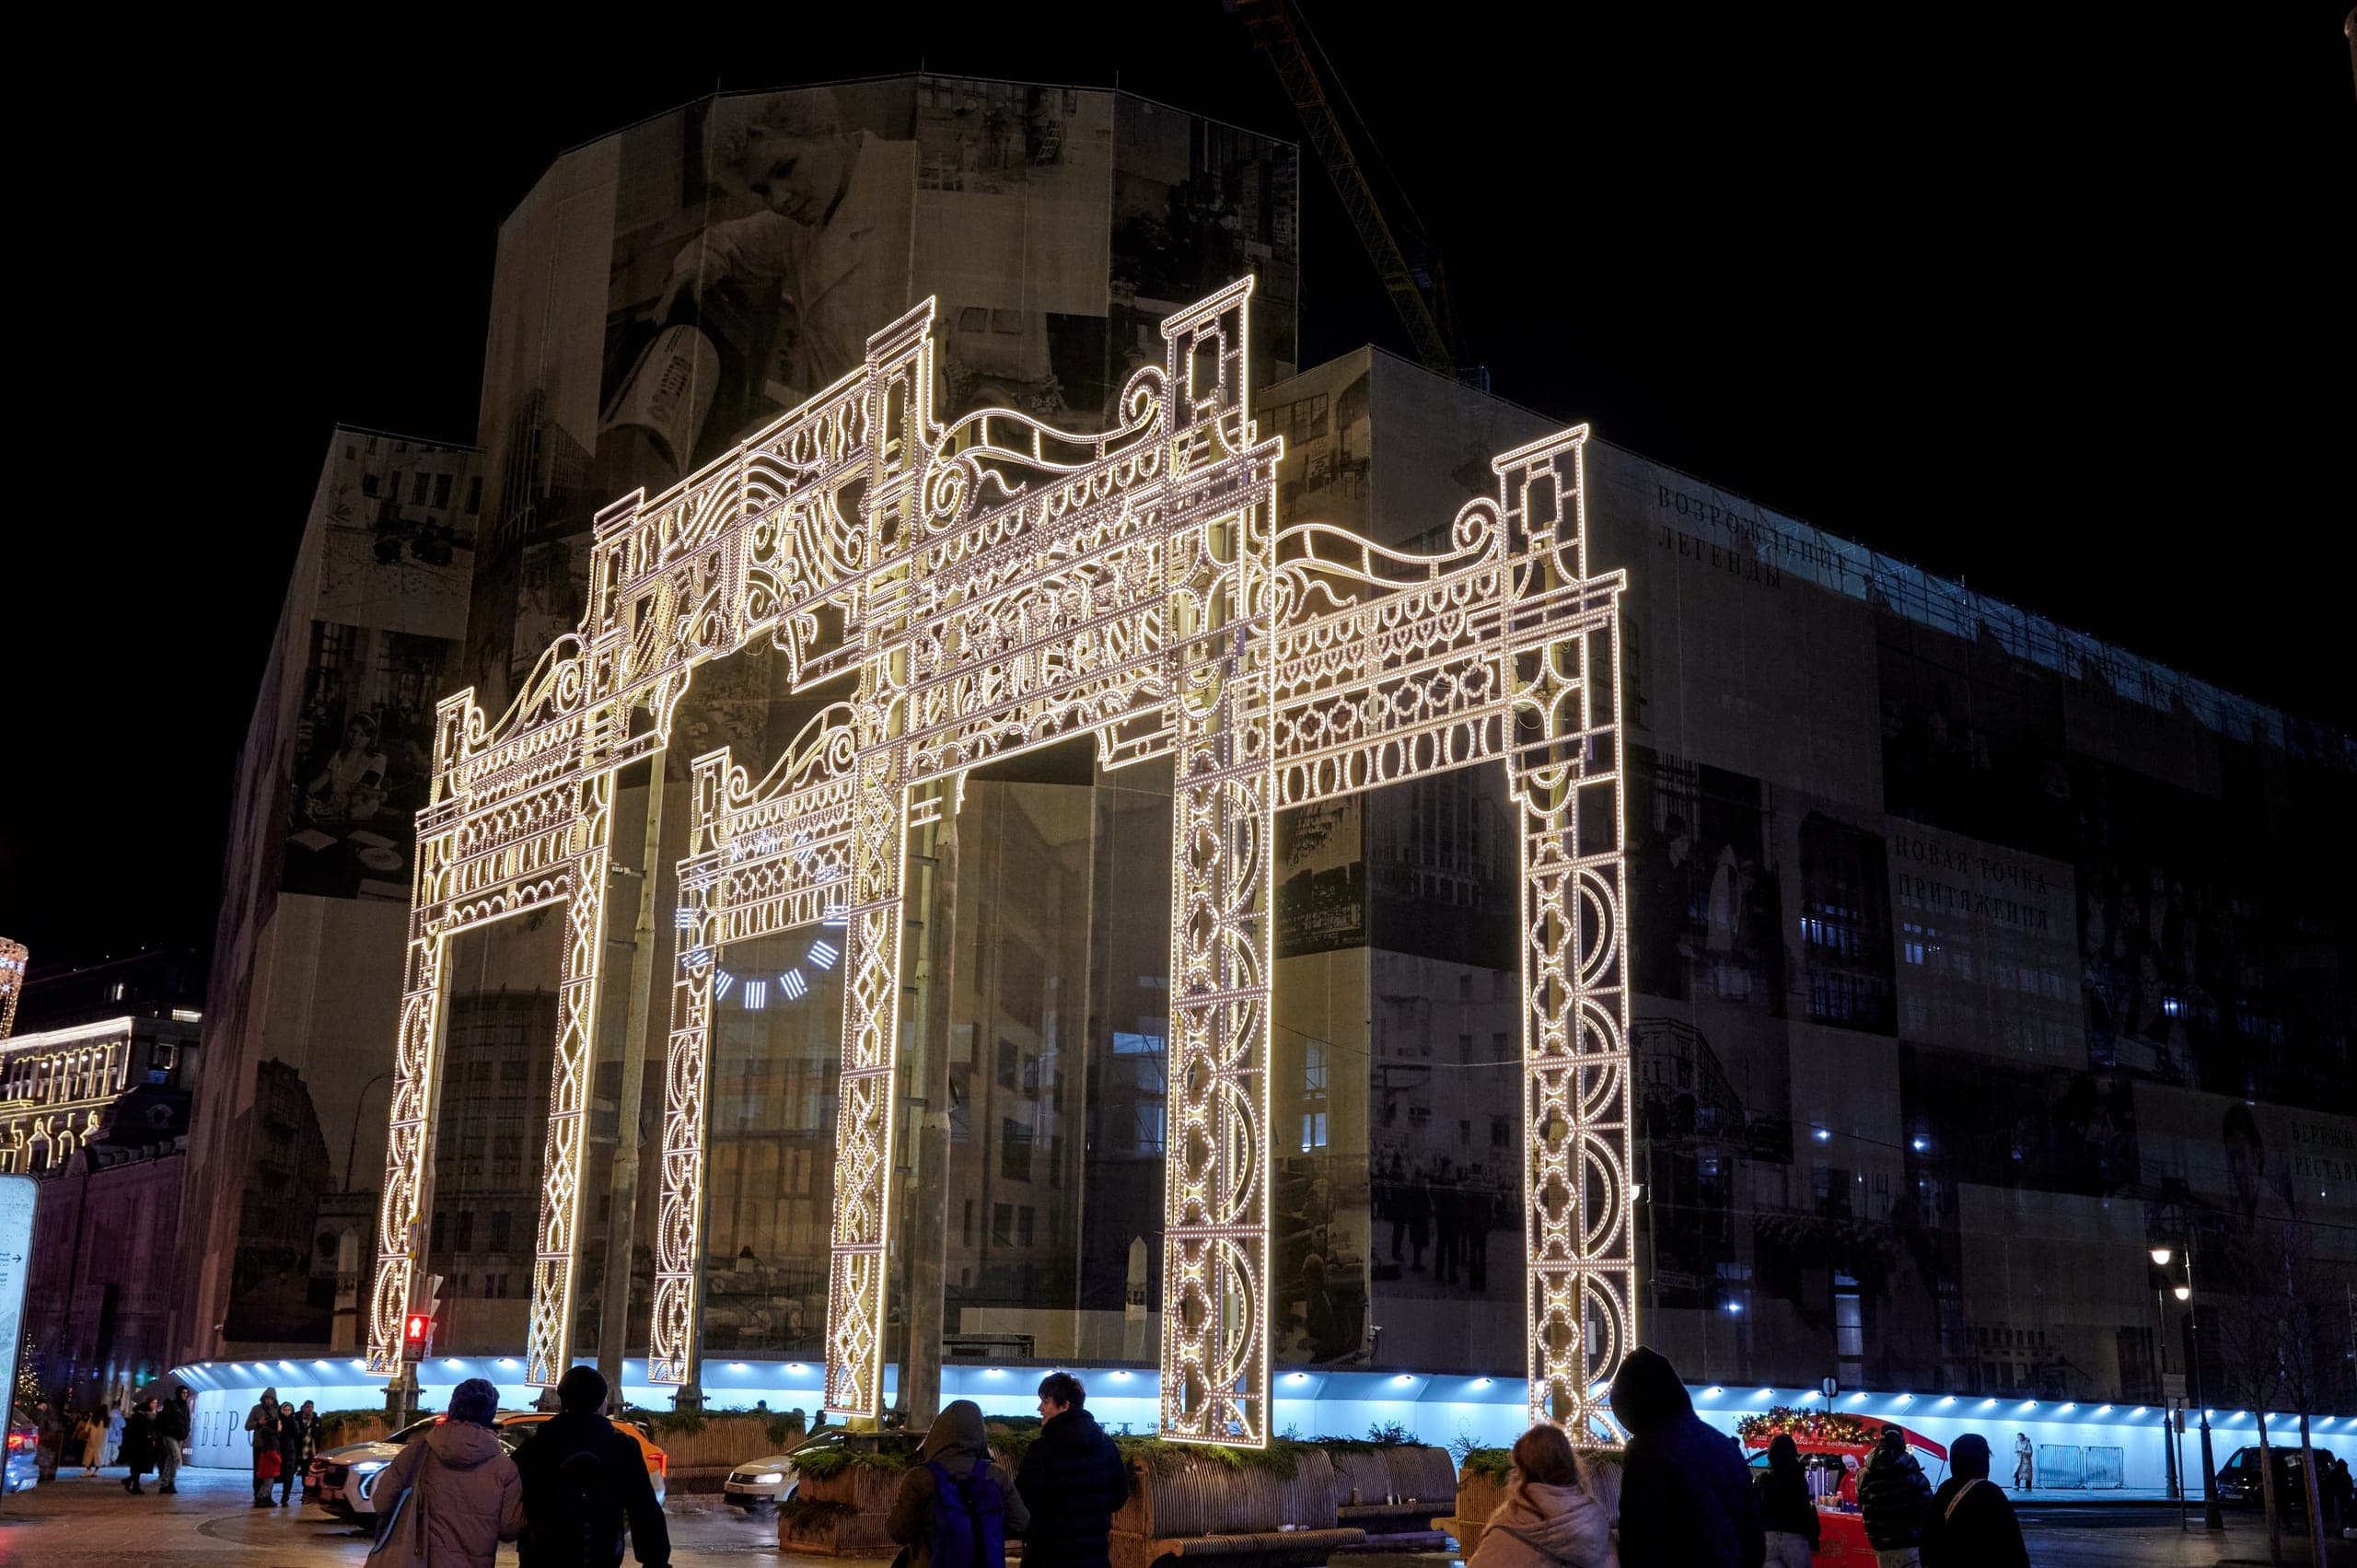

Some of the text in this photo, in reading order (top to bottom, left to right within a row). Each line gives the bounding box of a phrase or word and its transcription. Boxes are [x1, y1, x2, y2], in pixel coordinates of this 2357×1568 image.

[1658, 526, 1782, 589] ЛЕГЕНДЫ
[1896, 834, 2048, 894] НОВАЯ ТОЧКА
[1898, 873, 2048, 930] ПРИТЯЖЕНИЯ
[2295, 1155, 2357, 1182] РЕСТАВ
[197, 1411, 253, 1447] ВЕР
